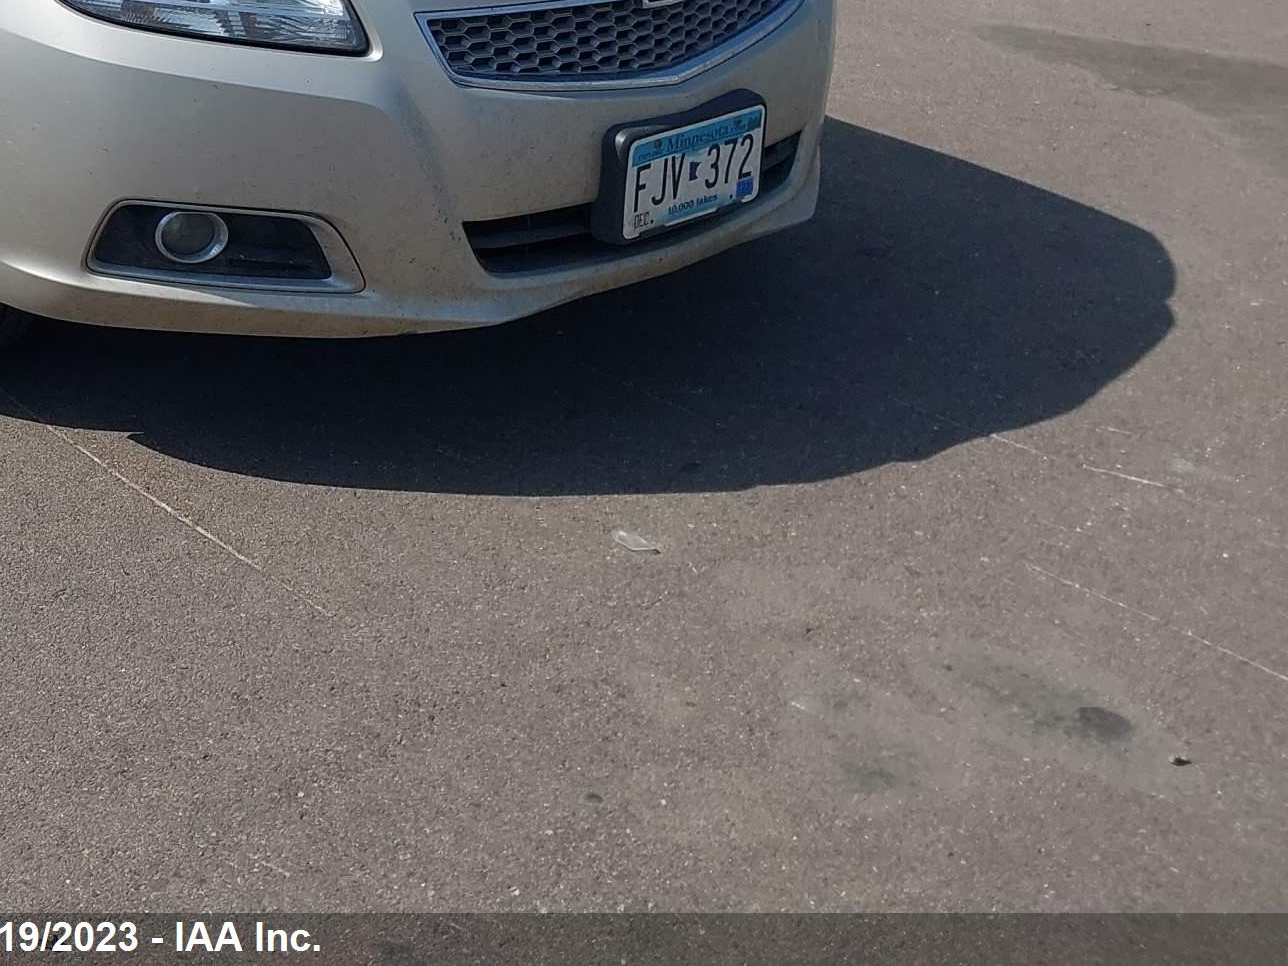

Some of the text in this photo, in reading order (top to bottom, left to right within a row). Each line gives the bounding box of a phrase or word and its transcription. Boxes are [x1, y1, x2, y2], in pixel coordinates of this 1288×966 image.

[666, 124, 729, 153] Minnesota
[633, 133, 754, 213] FJV 372
